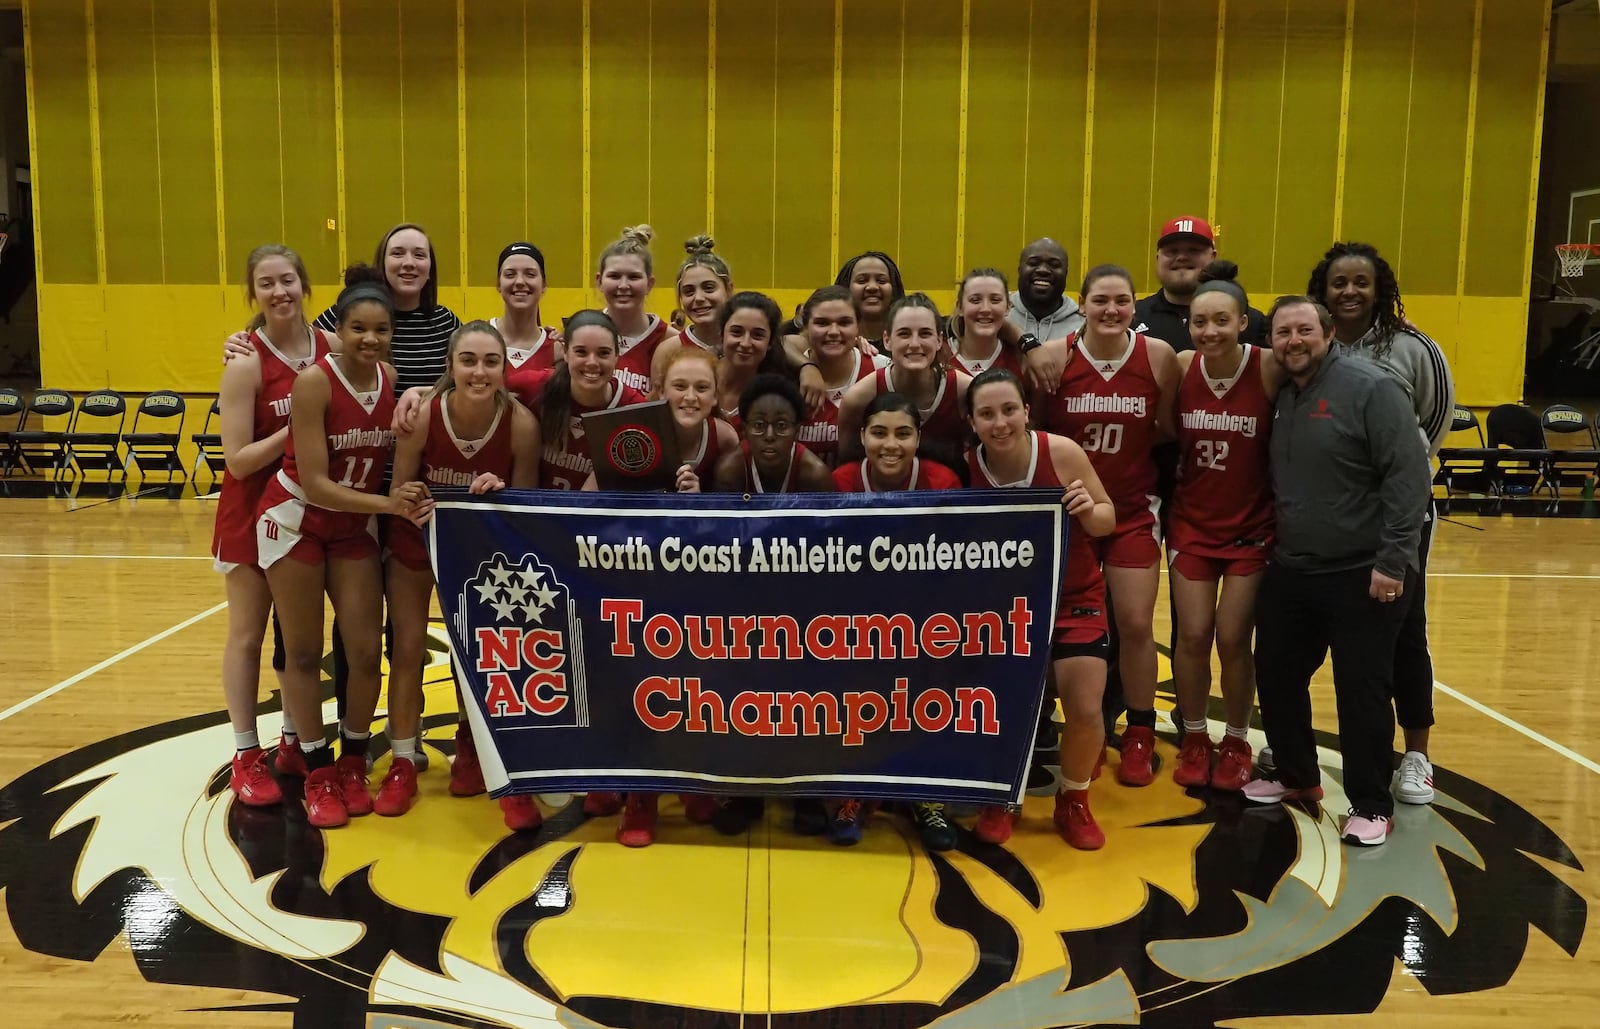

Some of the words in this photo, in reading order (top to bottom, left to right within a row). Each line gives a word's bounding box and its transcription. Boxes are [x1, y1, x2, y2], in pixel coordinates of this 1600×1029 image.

[1082, 423, 1124, 454] 30
[1195, 440, 1230, 471] 32
[337, 455, 374, 489] 11
[576, 534, 653, 573] North
[659, 537, 742, 574] Coast
[748, 536, 861, 574] Athletic
[870, 533, 1035, 573] Conference
[475, 626, 567, 673] NC
[600, 596, 1033, 661] Tournament
[484, 672, 568, 718] AC
[632, 676, 1001, 747] Champion
